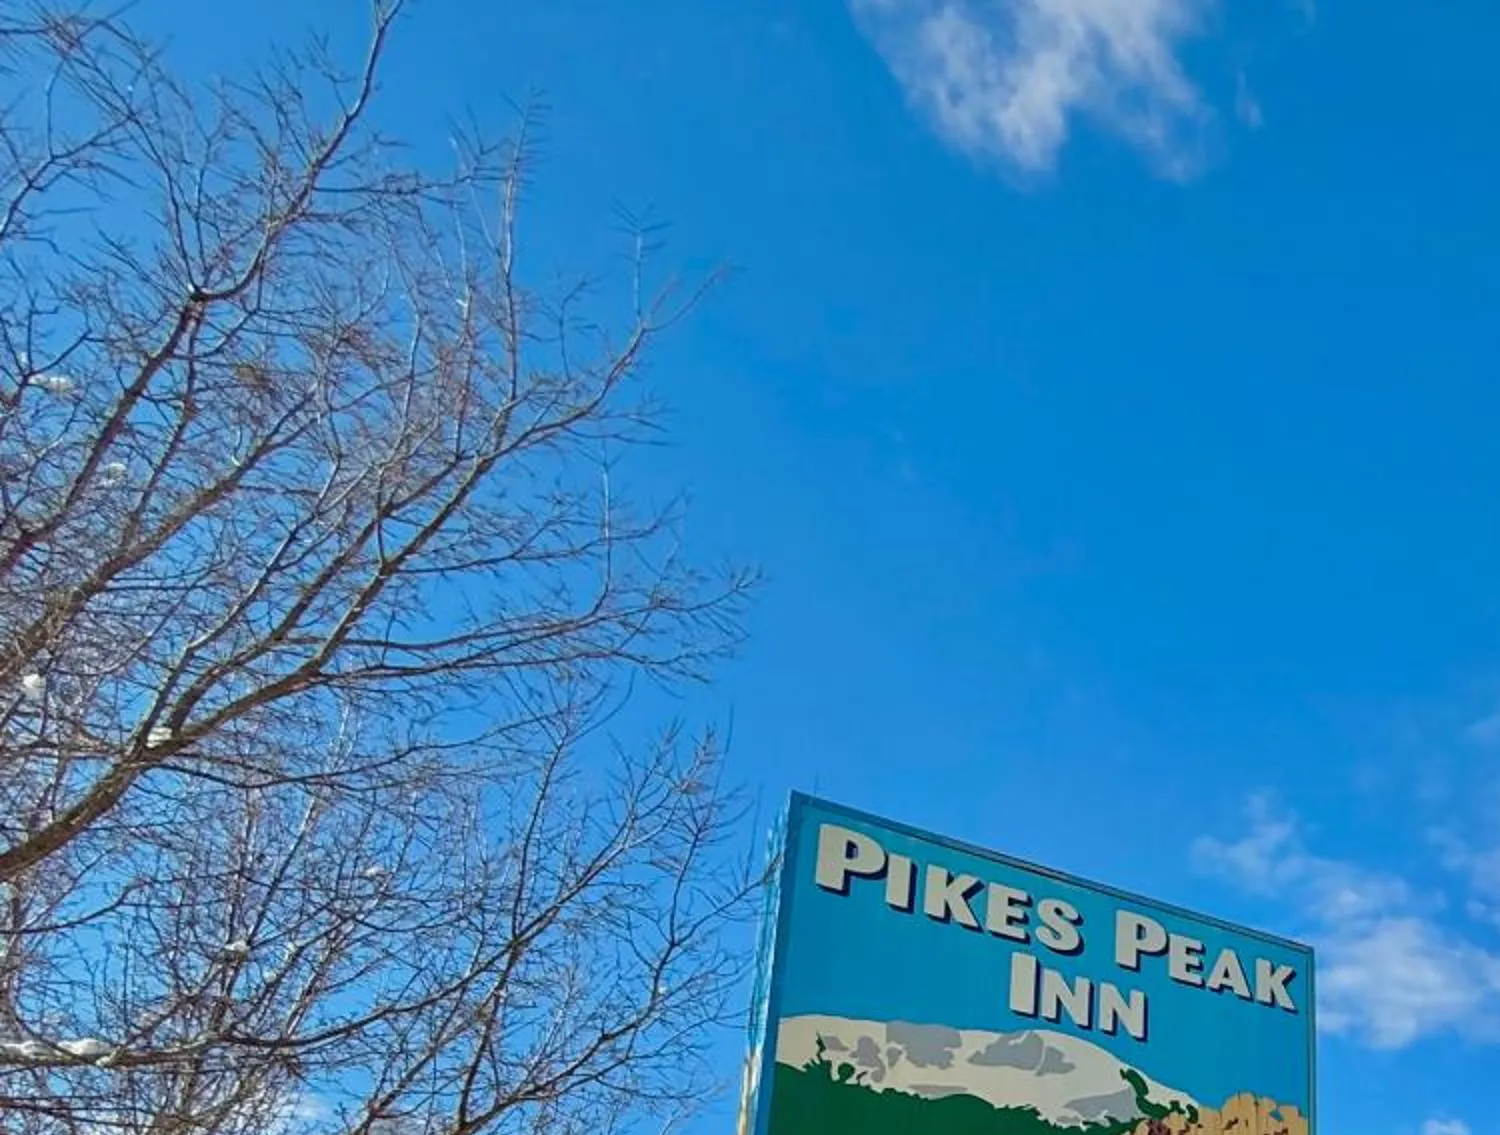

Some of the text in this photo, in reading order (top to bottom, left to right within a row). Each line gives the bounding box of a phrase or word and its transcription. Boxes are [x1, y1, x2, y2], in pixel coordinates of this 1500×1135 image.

[815, 823, 1297, 1012] PIKES PEAK
[1009, 951, 1147, 1041] INN
